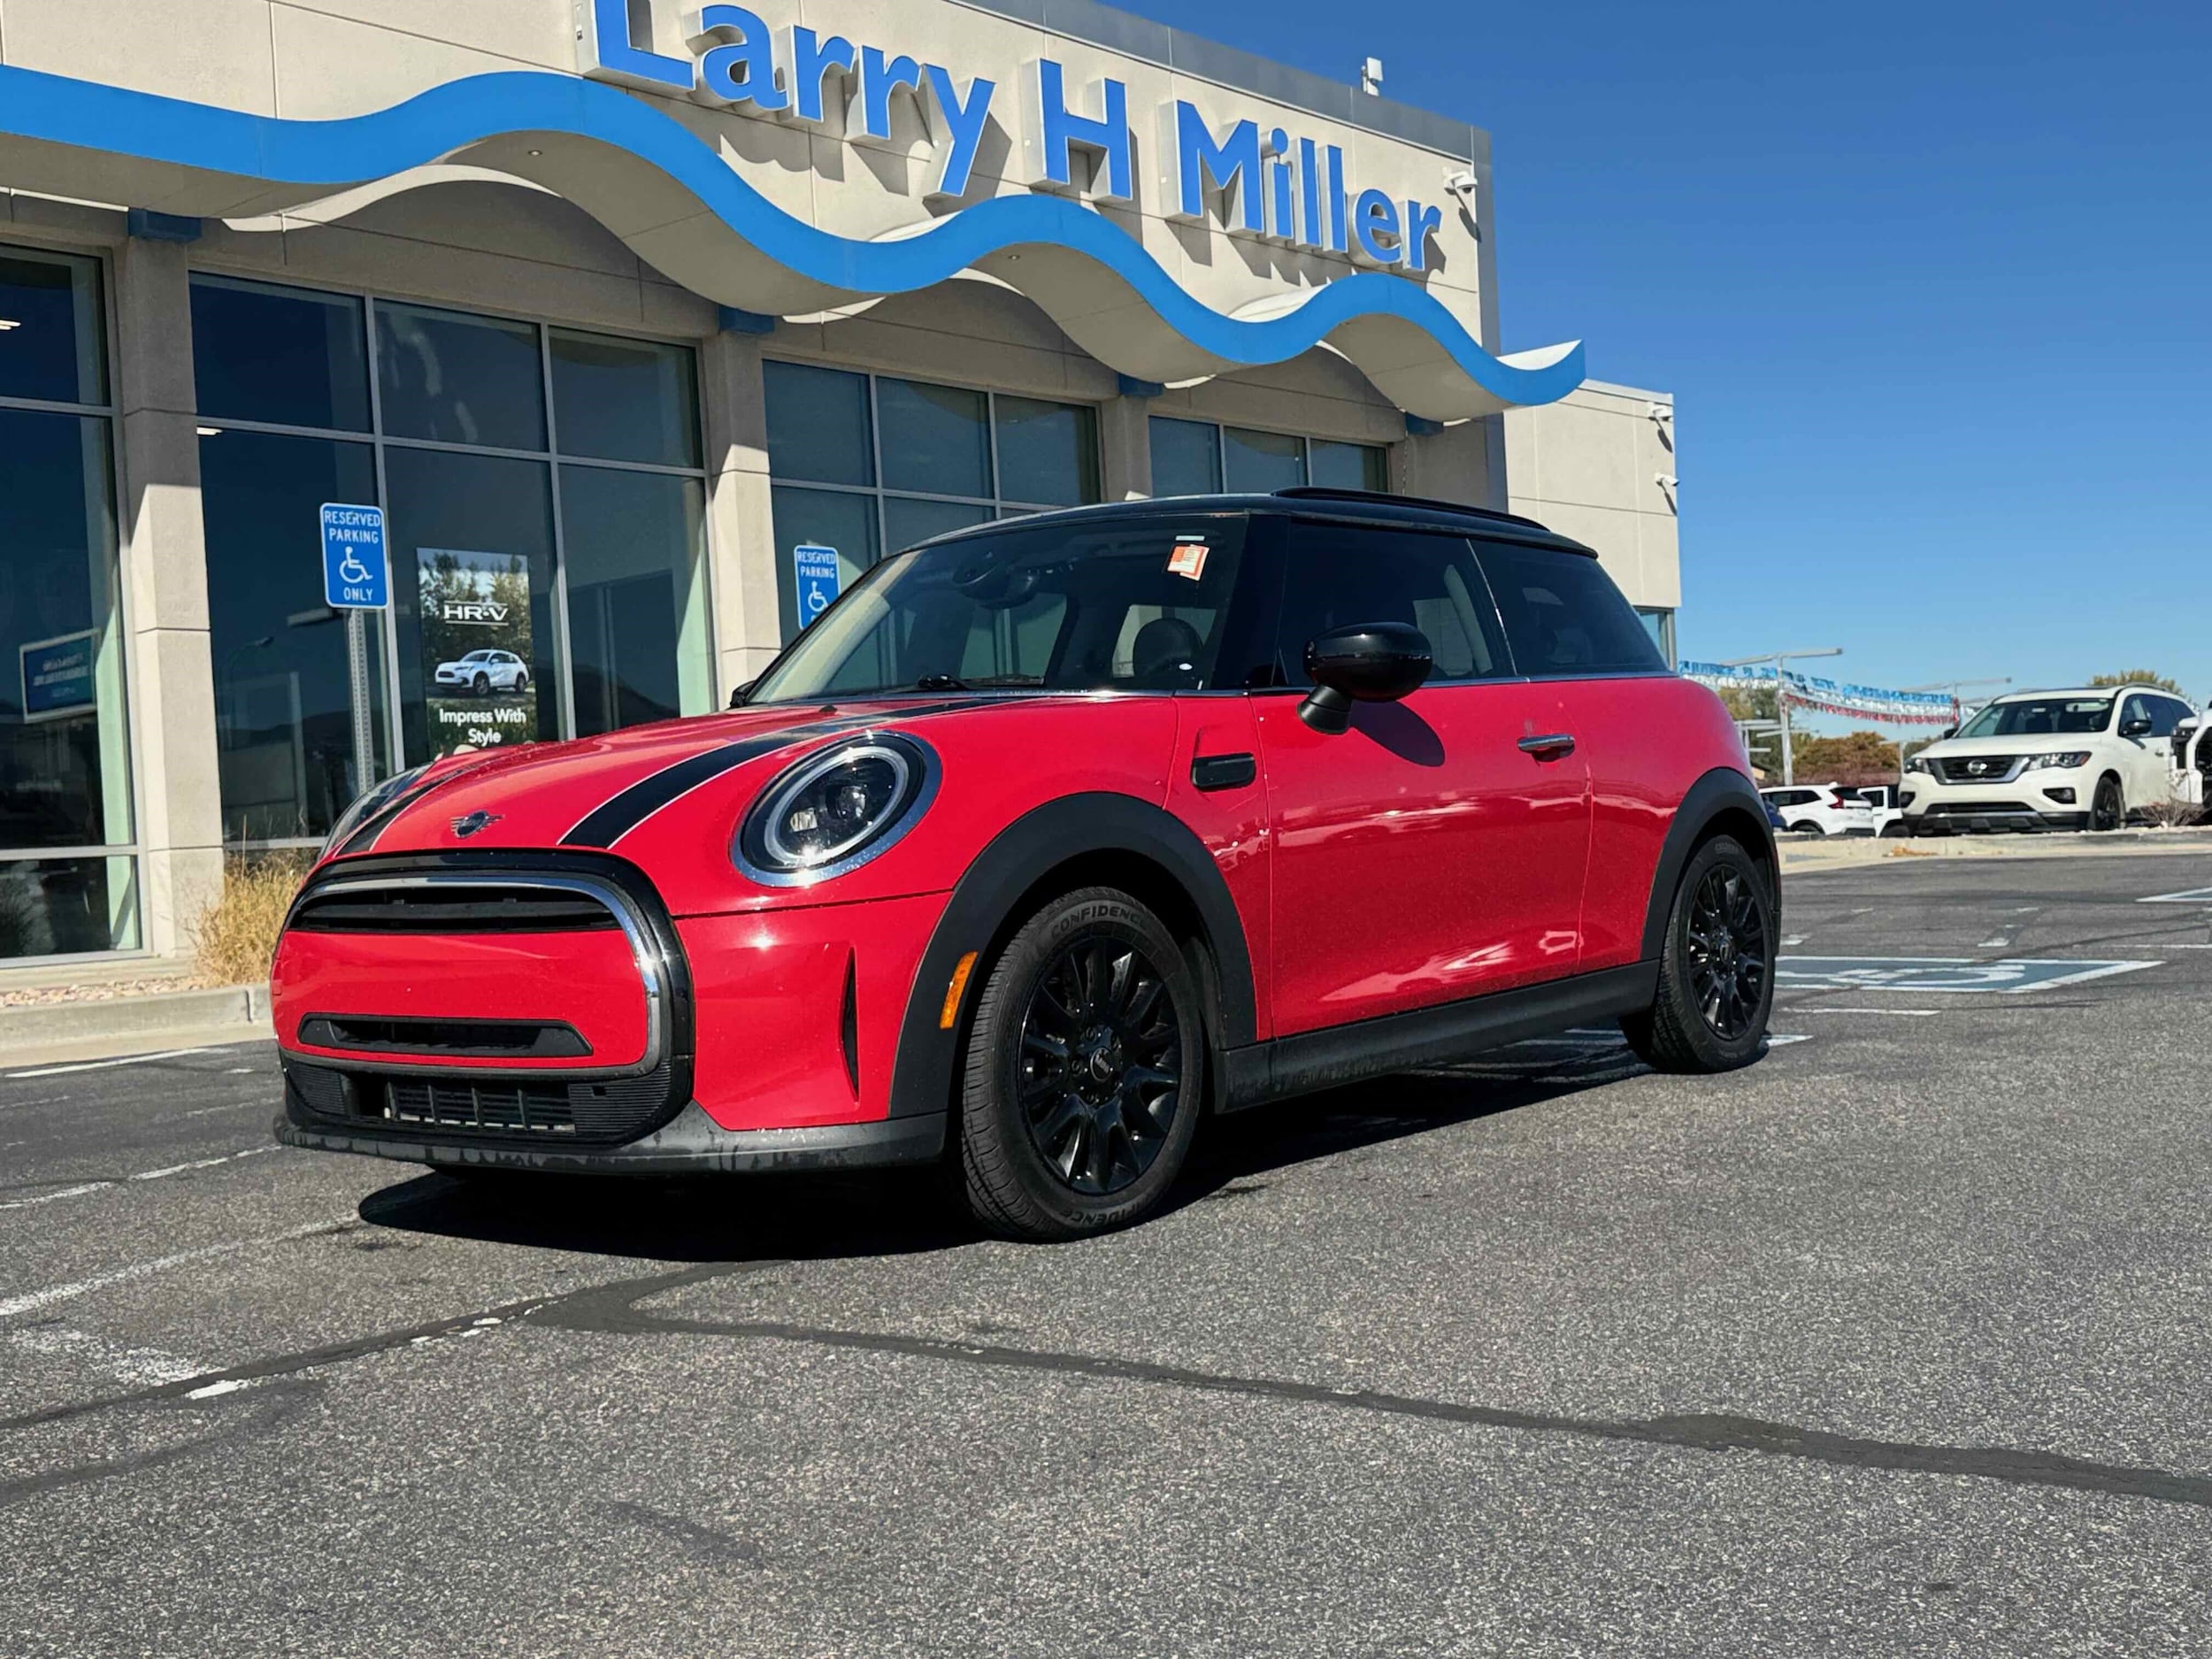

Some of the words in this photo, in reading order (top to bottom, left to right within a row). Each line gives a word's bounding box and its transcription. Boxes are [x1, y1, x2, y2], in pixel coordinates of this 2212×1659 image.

[591, 0, 996, 197] Larry
[1039, 58, 1133, 201] H
[1176, 99, 1442, 272] Miller
[324, 511, 380, 526] RESERVED
[328, 528, 379, 544] PARKING
[797, 551, 836, 565] RESERVED
[800, 566, 835, 579] PARKING
[343, 587, 373, 602] ONLY
[439, 708, 493, 726] Impress
[494, 709, 526, 724] With
[468, 727, 502, 747] Style
